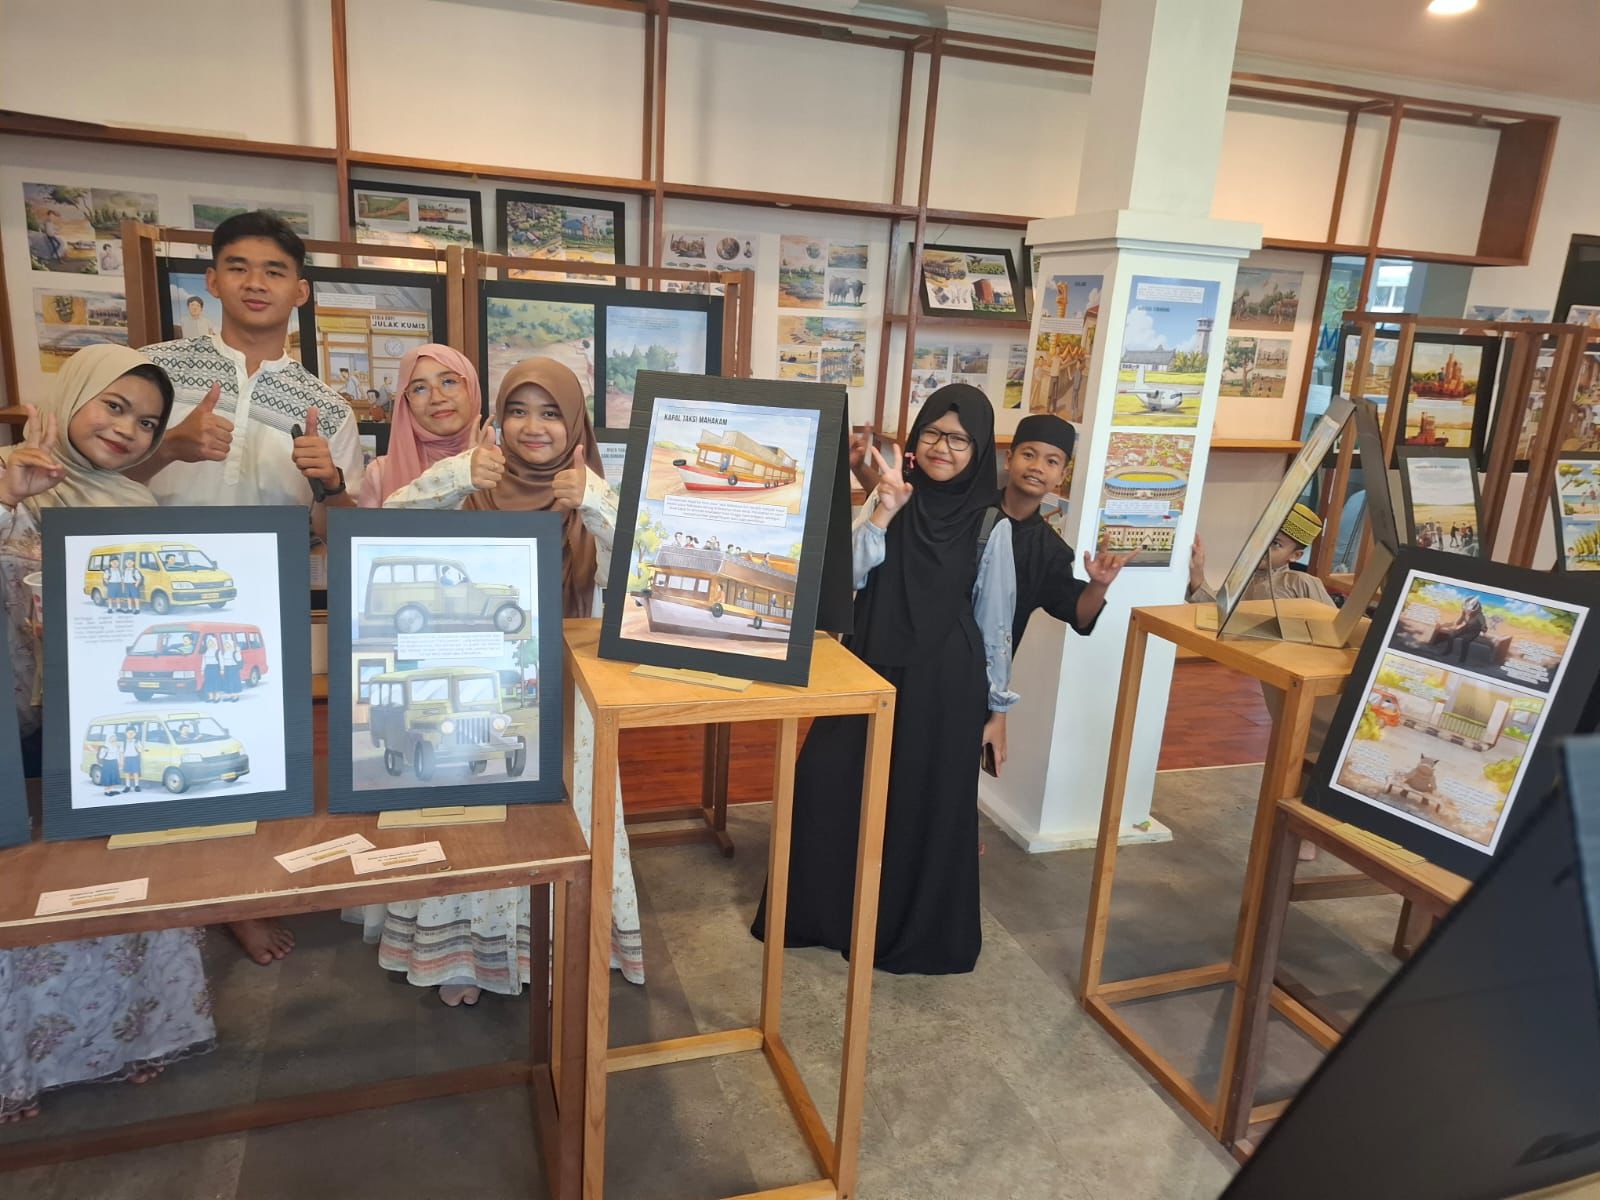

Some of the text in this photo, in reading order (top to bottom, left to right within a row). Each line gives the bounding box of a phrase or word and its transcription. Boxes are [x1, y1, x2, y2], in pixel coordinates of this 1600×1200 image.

[372, 320, 399, 328] JULAK
[682, 415, 698, 424] TAKSI
[699, 415, 728, 426] MAHAKAM
